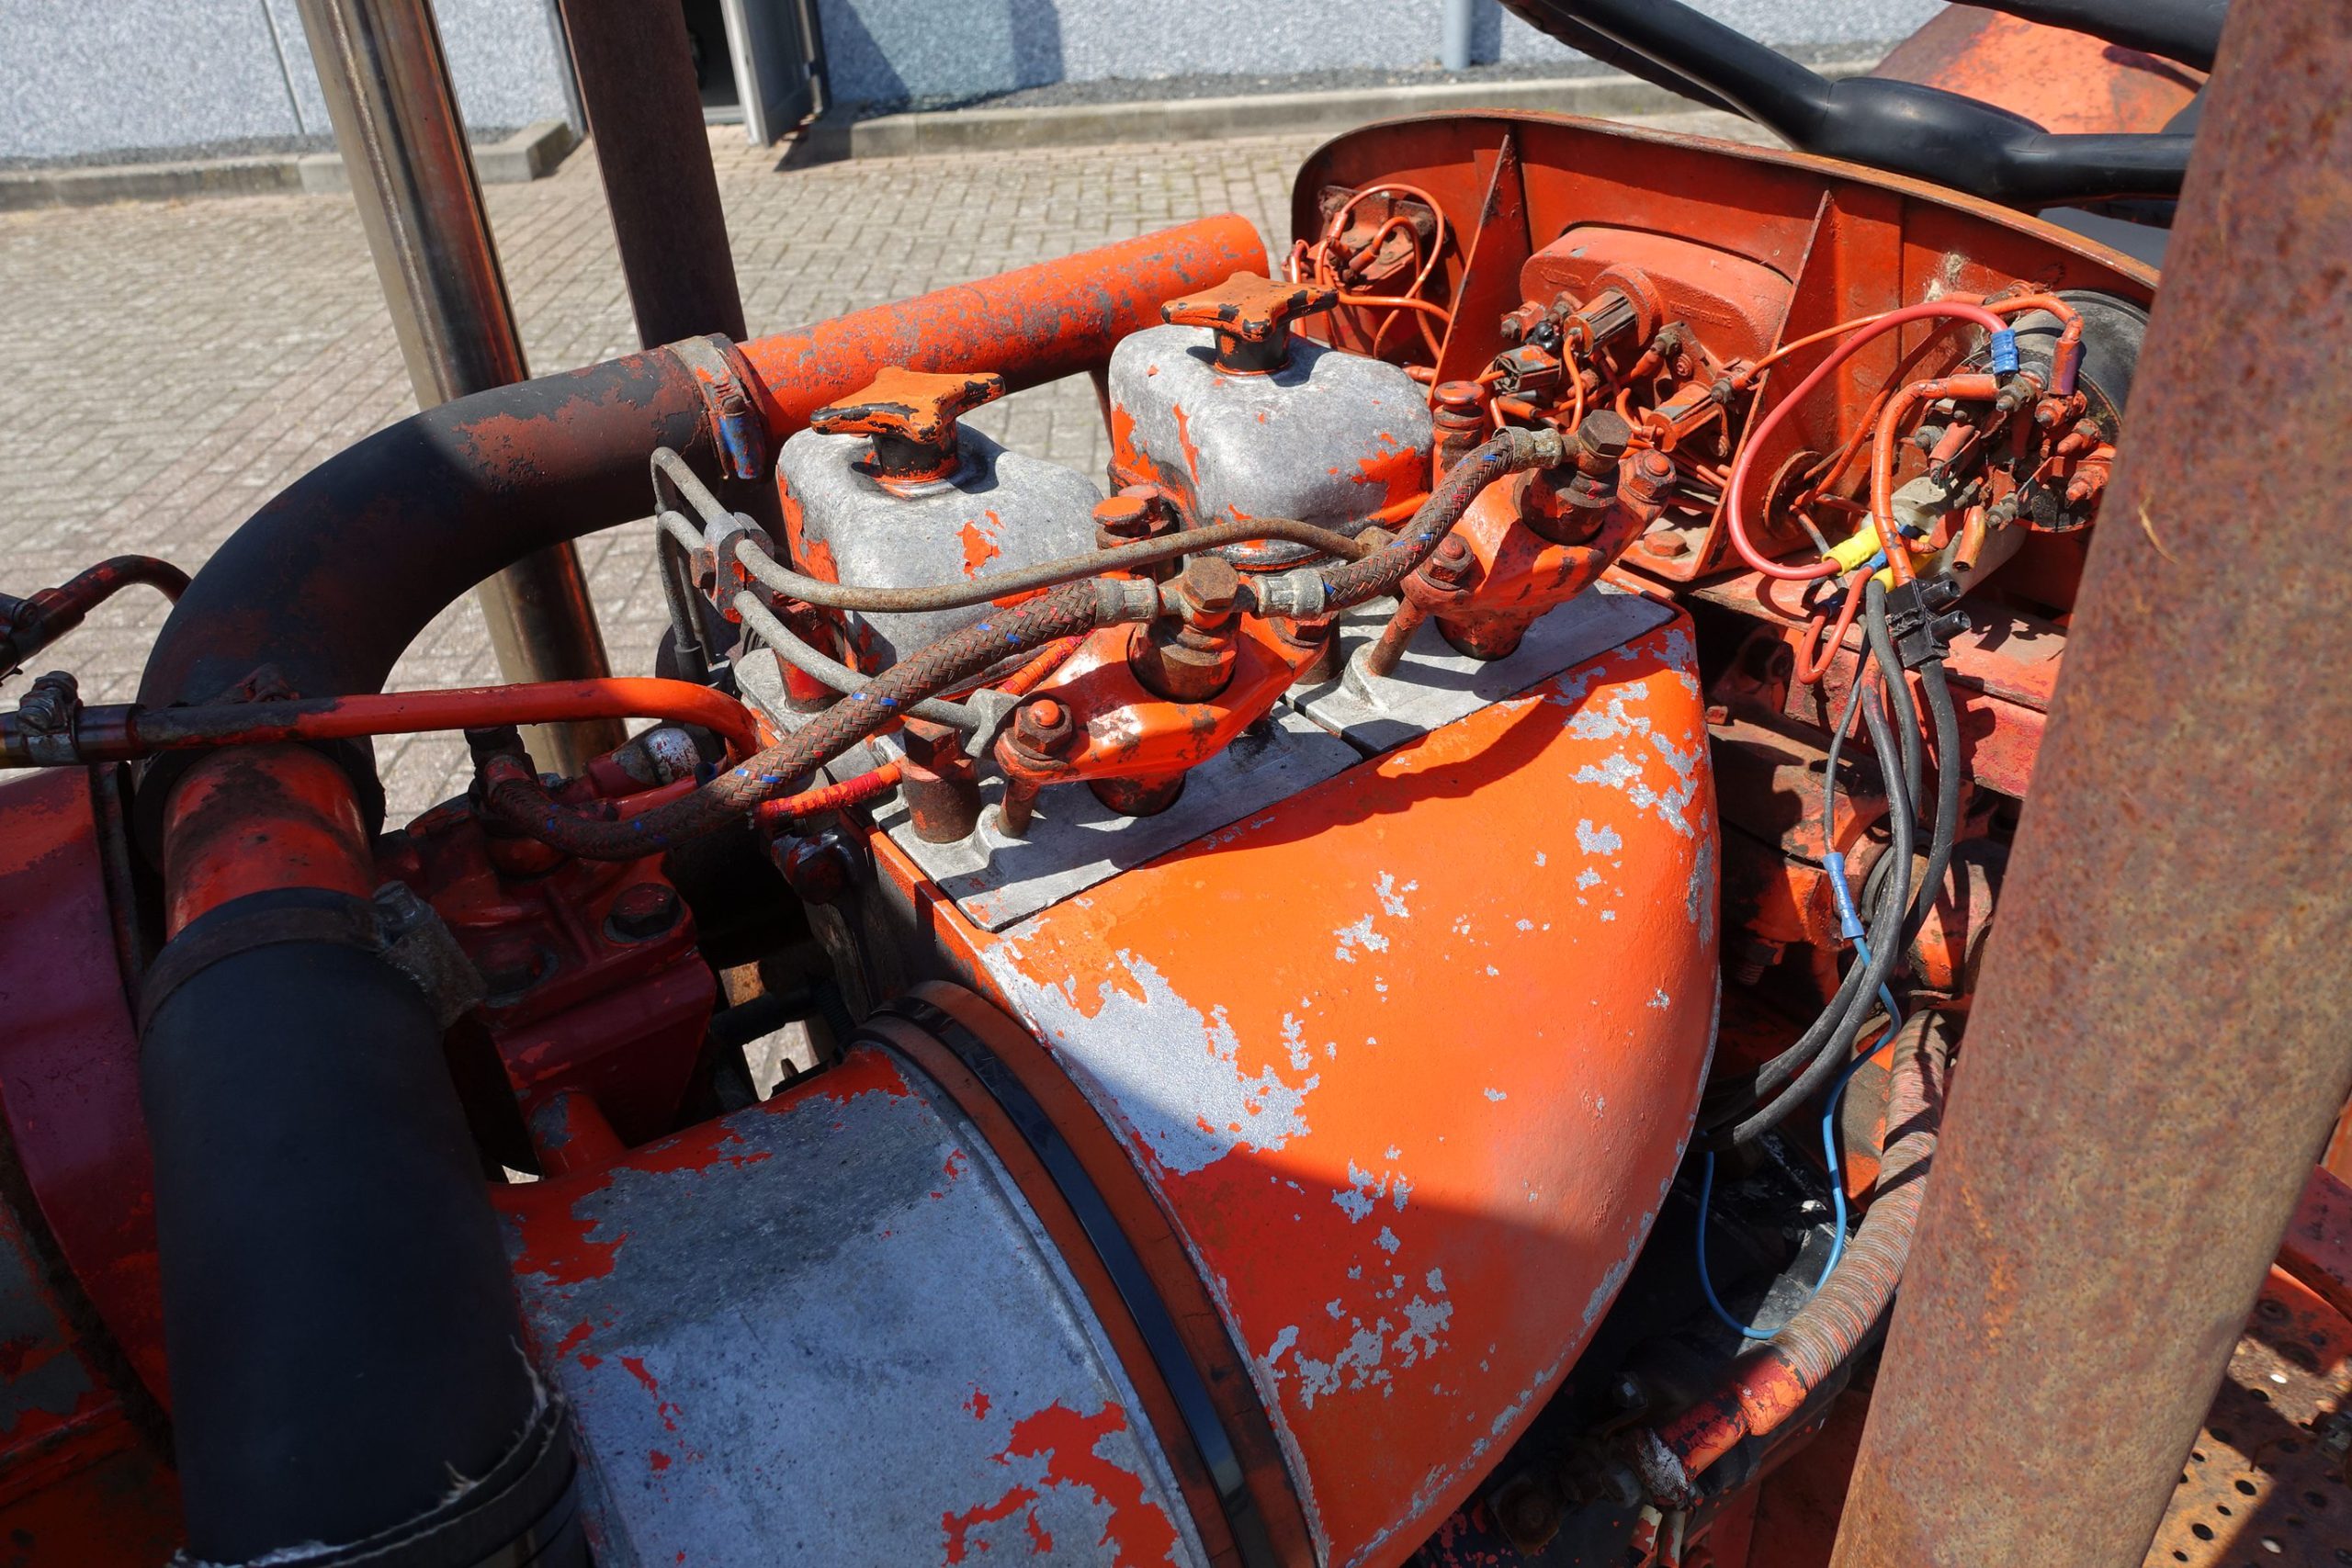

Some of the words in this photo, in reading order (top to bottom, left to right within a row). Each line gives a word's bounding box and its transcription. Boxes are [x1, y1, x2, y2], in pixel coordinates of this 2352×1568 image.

[1668, 299, 1691, 318] MADE
[1691, 306, 1700, 321] IN
[1700, 310, 1732, 329] FRANCE
